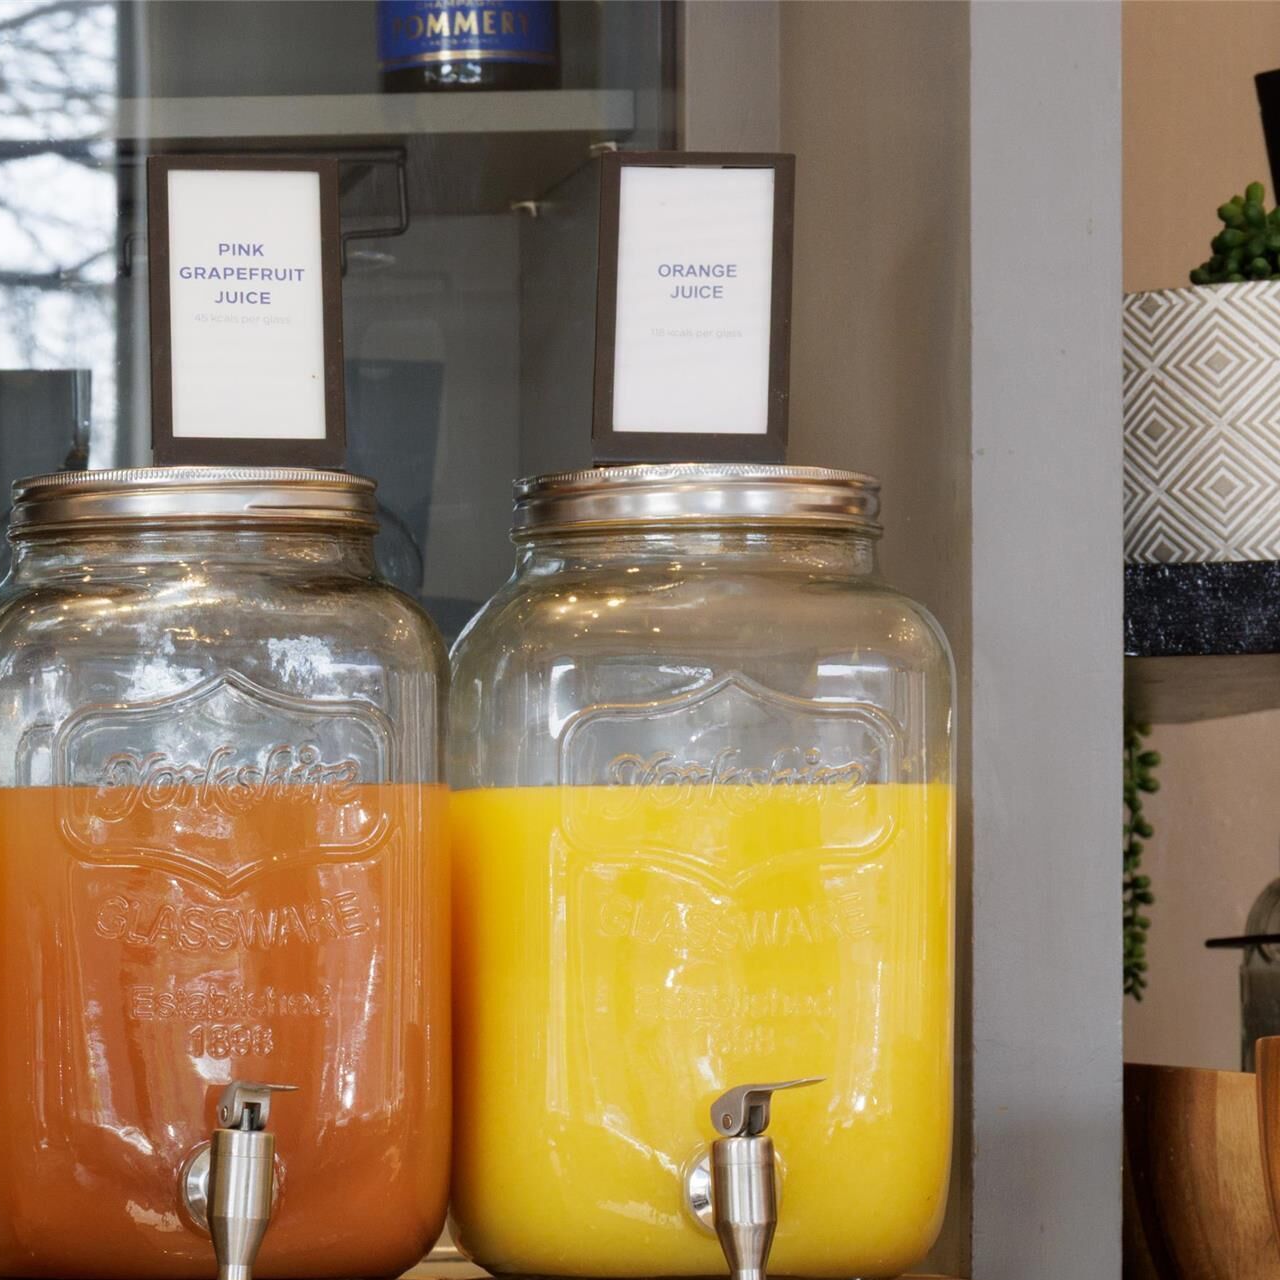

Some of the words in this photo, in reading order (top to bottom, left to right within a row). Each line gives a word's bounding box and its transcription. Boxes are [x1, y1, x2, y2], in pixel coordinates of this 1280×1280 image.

[393, 9, 529, 40] POMMERY
[218, 243, 264, 257] PINK
[179, 266, 305, 282] GRAPEFRUIT
[658, 264, 737, 278] ORANGE
[214, 291, 271, 305] JUICE
[670, 285, 724, 299] JUICE
[91, 744, 363, 822] Yorkshire
[93, 891, 373, 952] GLASSWARE
